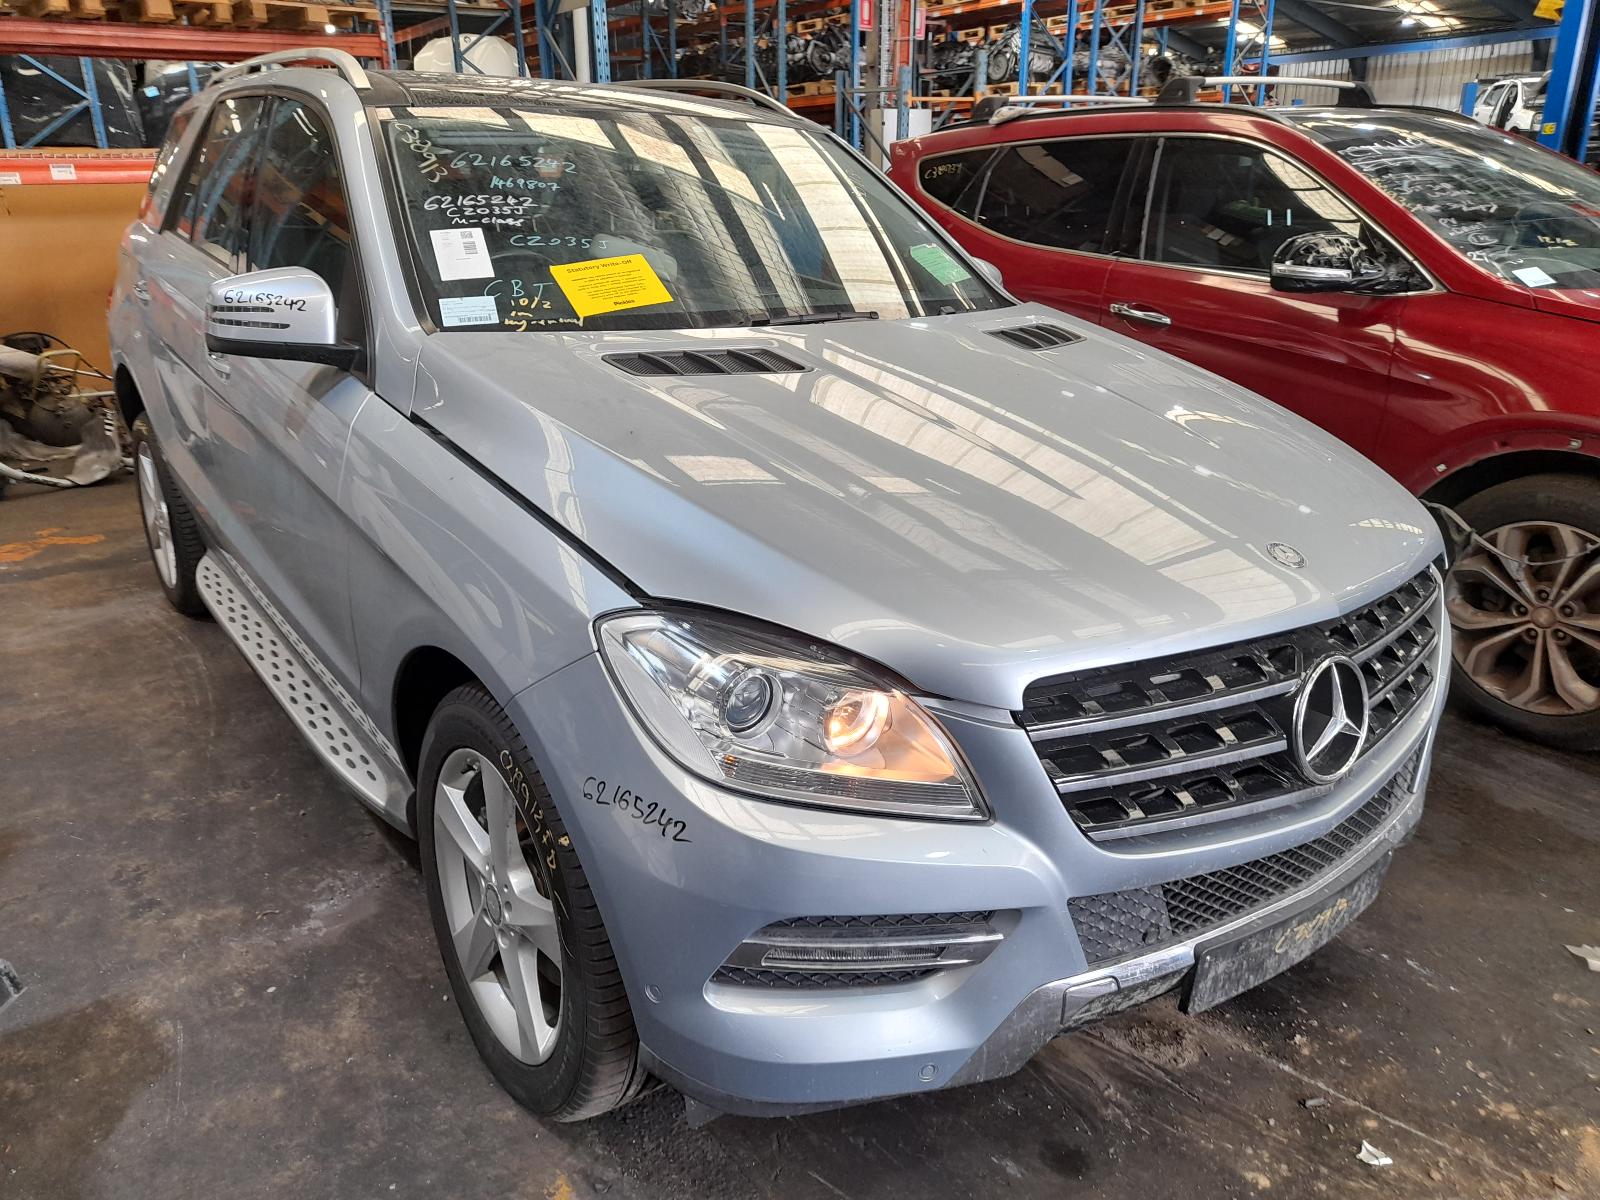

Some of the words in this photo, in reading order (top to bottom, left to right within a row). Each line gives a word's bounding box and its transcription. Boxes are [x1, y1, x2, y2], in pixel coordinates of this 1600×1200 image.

[394, 122, 449, 183] C38913
[449, 151, 578, 174] 62165242
[423, 194, 540, 211] 62165242
[566, 264, 600, 274] Statutory
[223, 289, 307, 312] 62165242
[582, 776, 693, 843] 62165242
